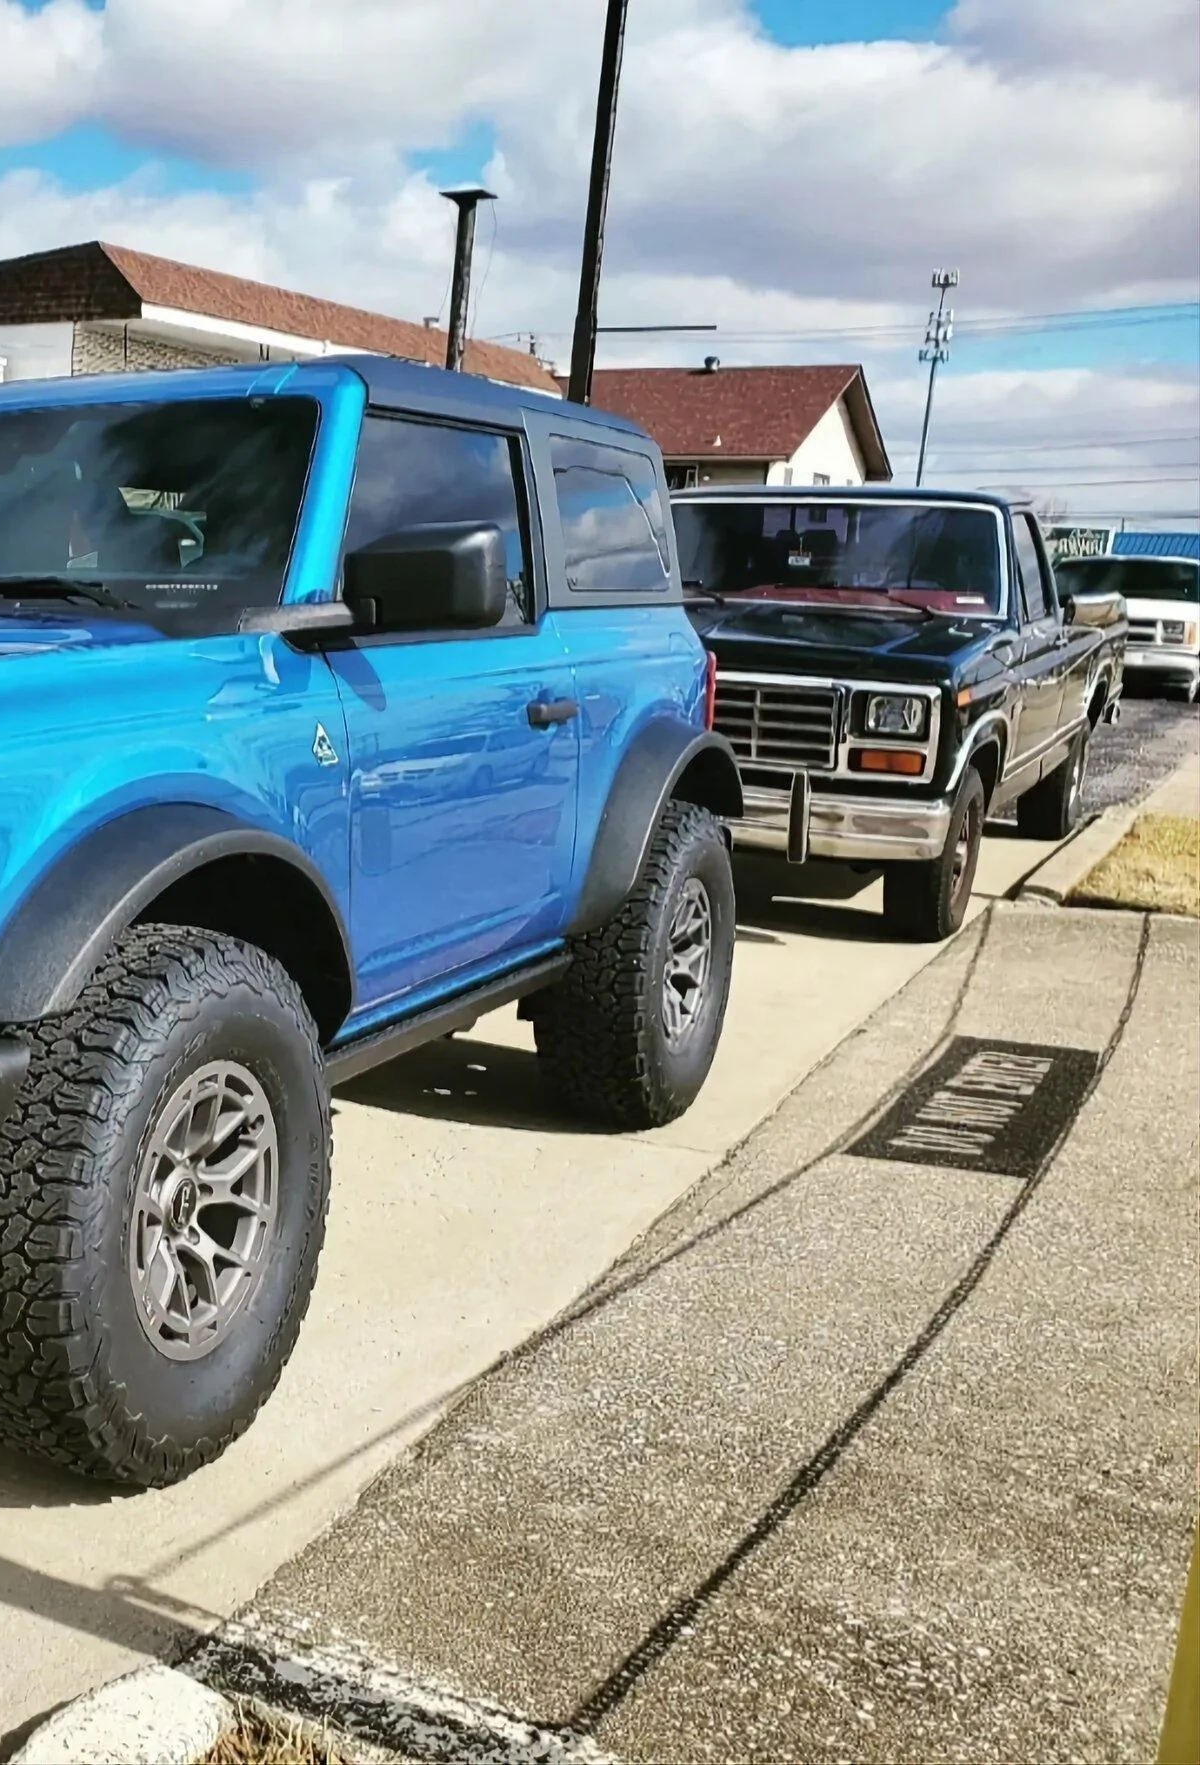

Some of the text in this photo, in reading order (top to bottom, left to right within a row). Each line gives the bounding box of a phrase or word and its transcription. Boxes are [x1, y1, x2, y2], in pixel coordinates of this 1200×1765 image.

[886, 1051, 1055, 1156] DO NOT ENTER
